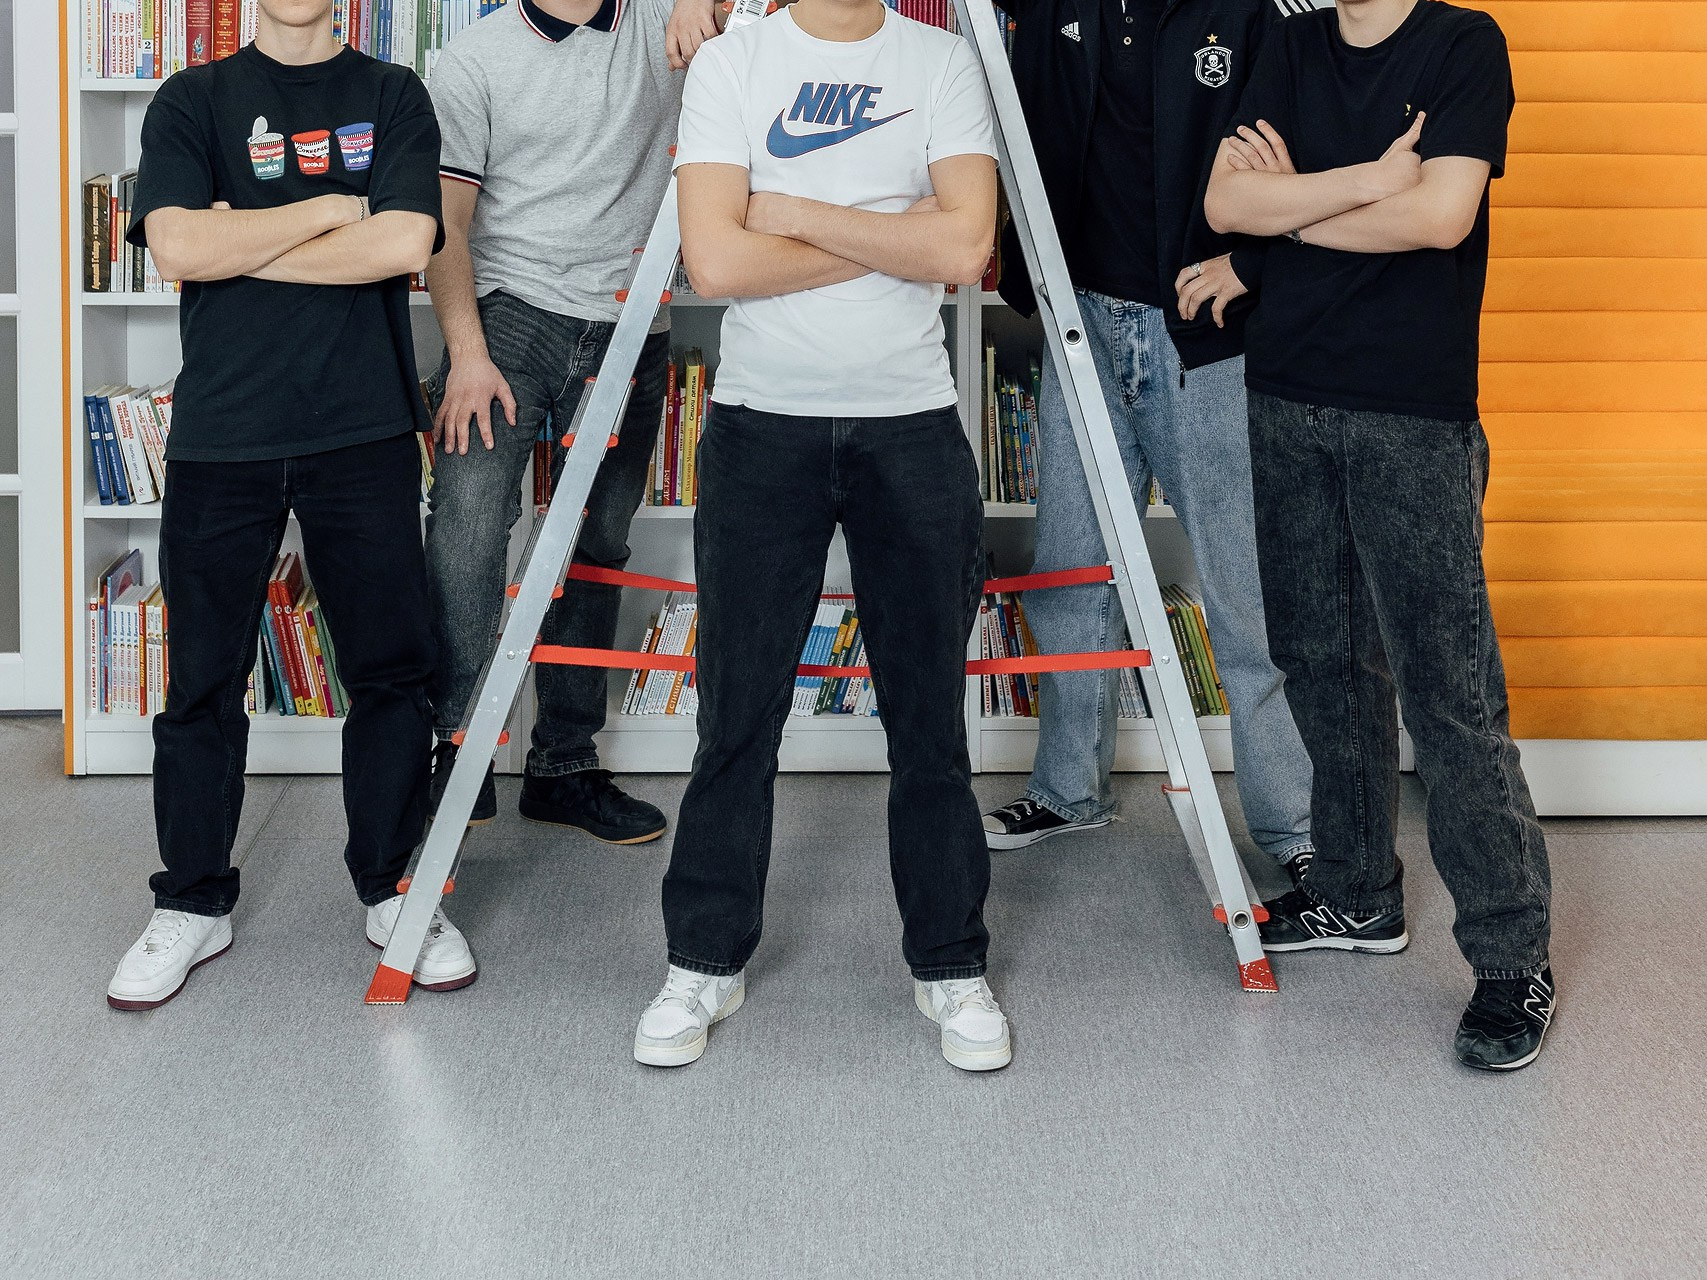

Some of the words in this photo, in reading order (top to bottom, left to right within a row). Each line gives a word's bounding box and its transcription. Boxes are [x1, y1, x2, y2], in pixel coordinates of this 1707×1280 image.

[1061, 27, 1081, 42] adidas
[144, 40, 151, 50] 2
[1200, 49, 1227, 60] ORLANDO
[787, 81, 883, 127] NIKE
[1301, 906, 1347, 938] N
